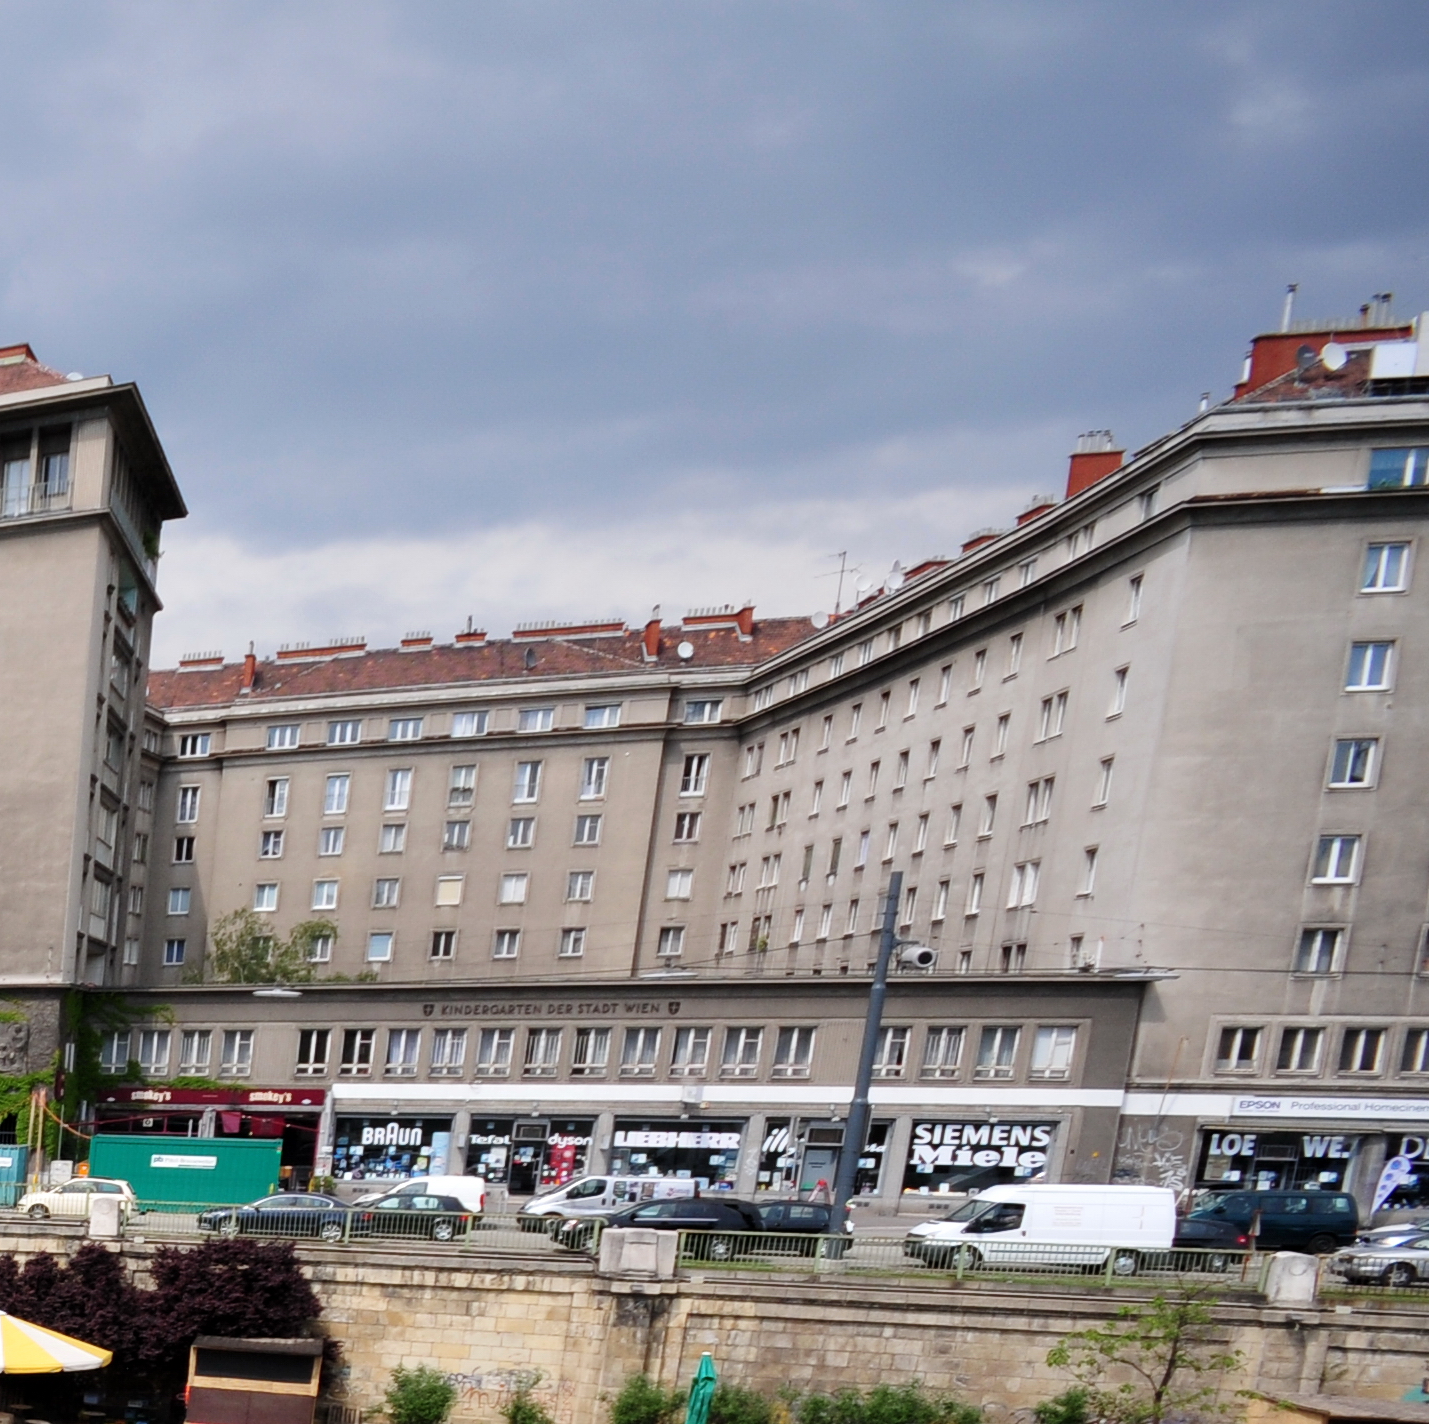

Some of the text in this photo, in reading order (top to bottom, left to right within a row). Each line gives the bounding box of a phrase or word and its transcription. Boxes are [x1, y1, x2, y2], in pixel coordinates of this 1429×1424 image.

[441, 1003, 660, 1015] KINDERGARTEN DER STADT WIEN
[249, 1091, 292, 1103] smokey's
[1239, 1100, 1280, 1109] EPSON
[1291, 1101, 1360, 1111] Professional
[361, 1122, 423, 1146] BRAUN
[469, 1134, 512, 1145] Tefal
[548, 1133, 592, 1149] dyson
[614, 1131, 741, 1149] LIEBHERR
[913, 1124, 1052, 1147] SIEMENS
[909, 1144, 1047, 1168] Miele
